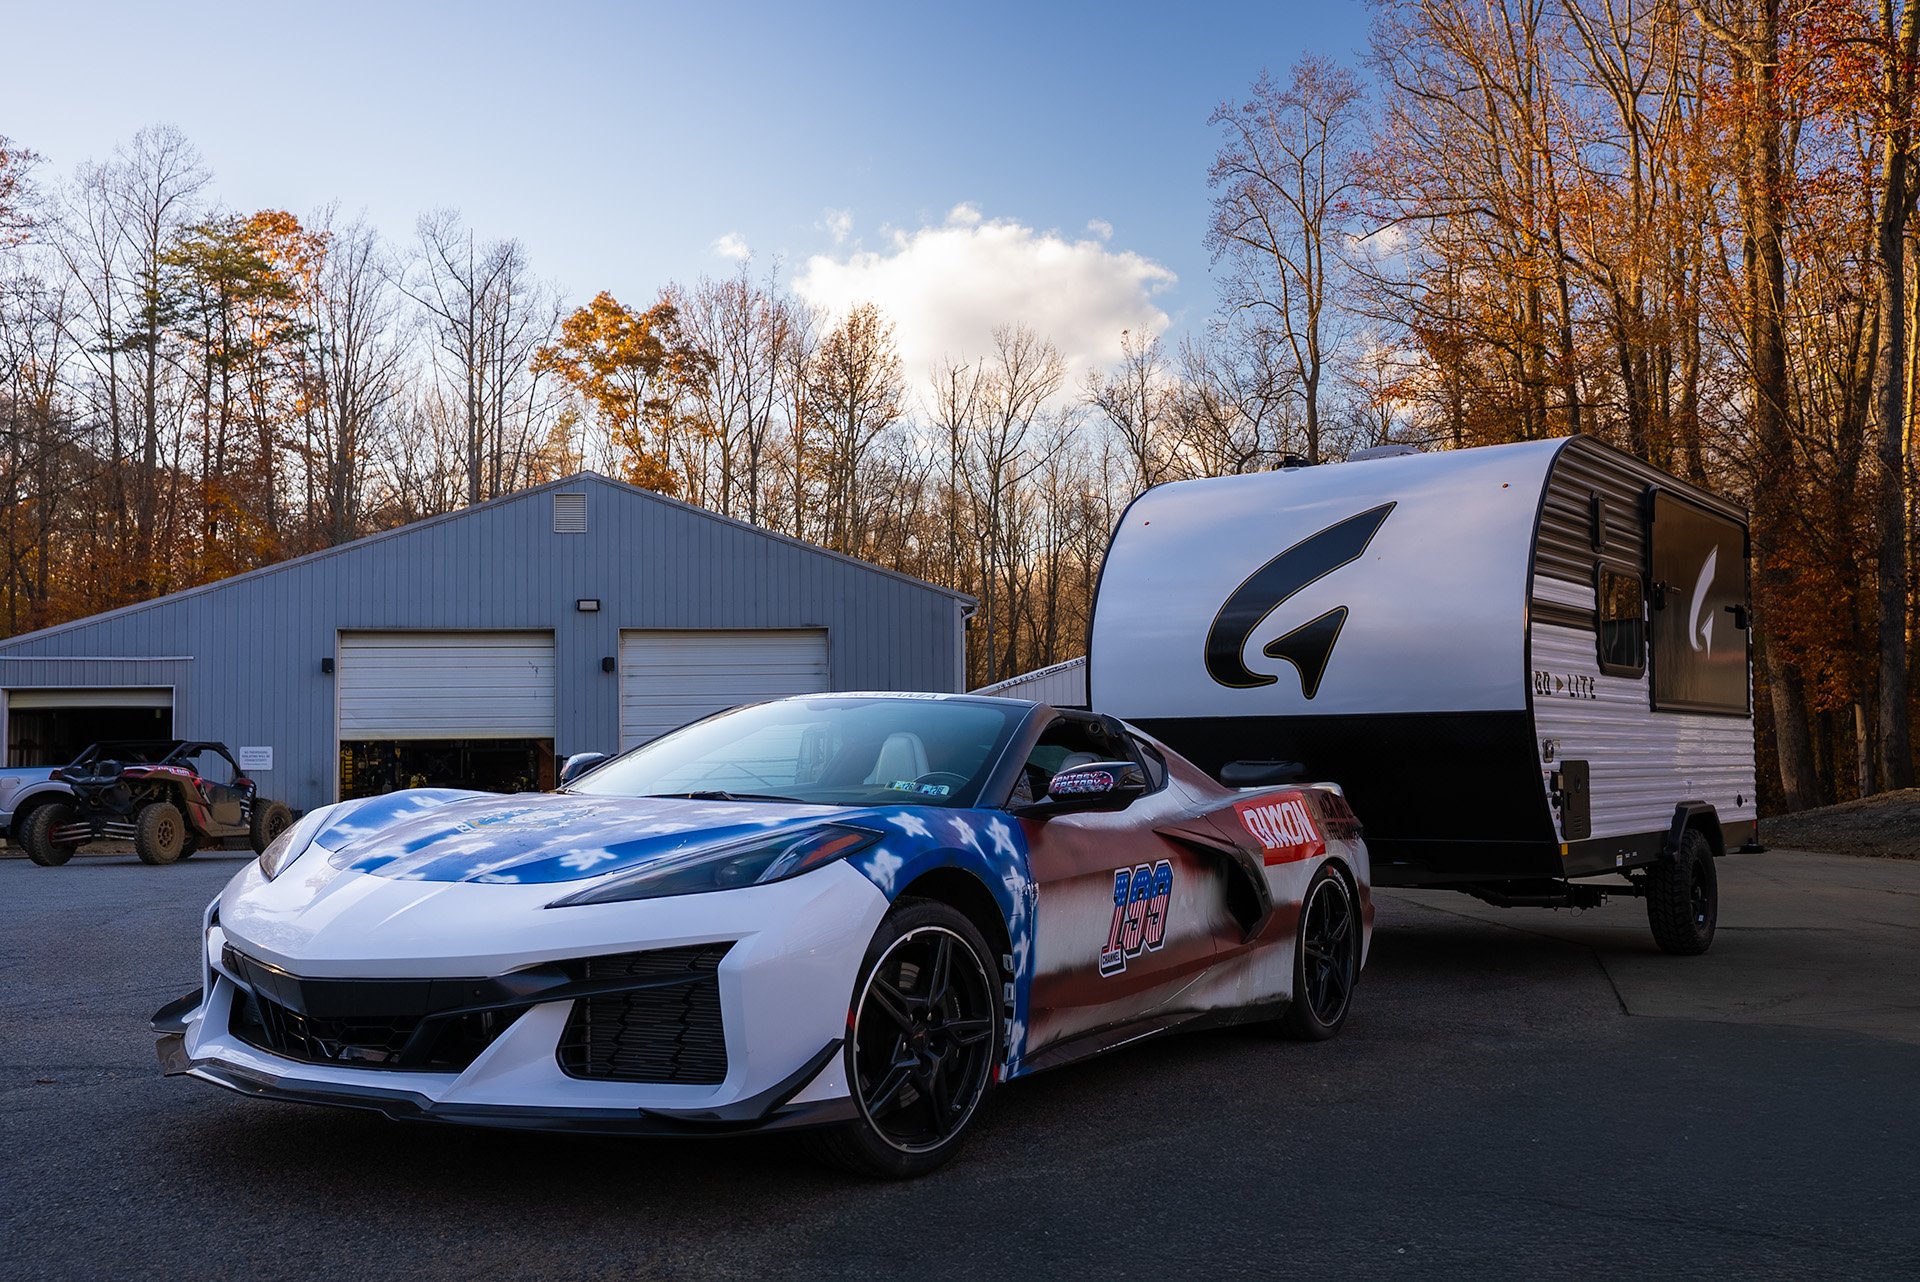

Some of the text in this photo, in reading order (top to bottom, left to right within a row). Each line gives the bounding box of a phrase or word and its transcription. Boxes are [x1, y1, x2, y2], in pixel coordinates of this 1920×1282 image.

[1534, 670, 1596, 699] GO LITE
[1055, 779, 1101, 790] FACTORY
[1243, 800, 1317, 849] DIXXON
[1105, 862, 1174, 957] 199
